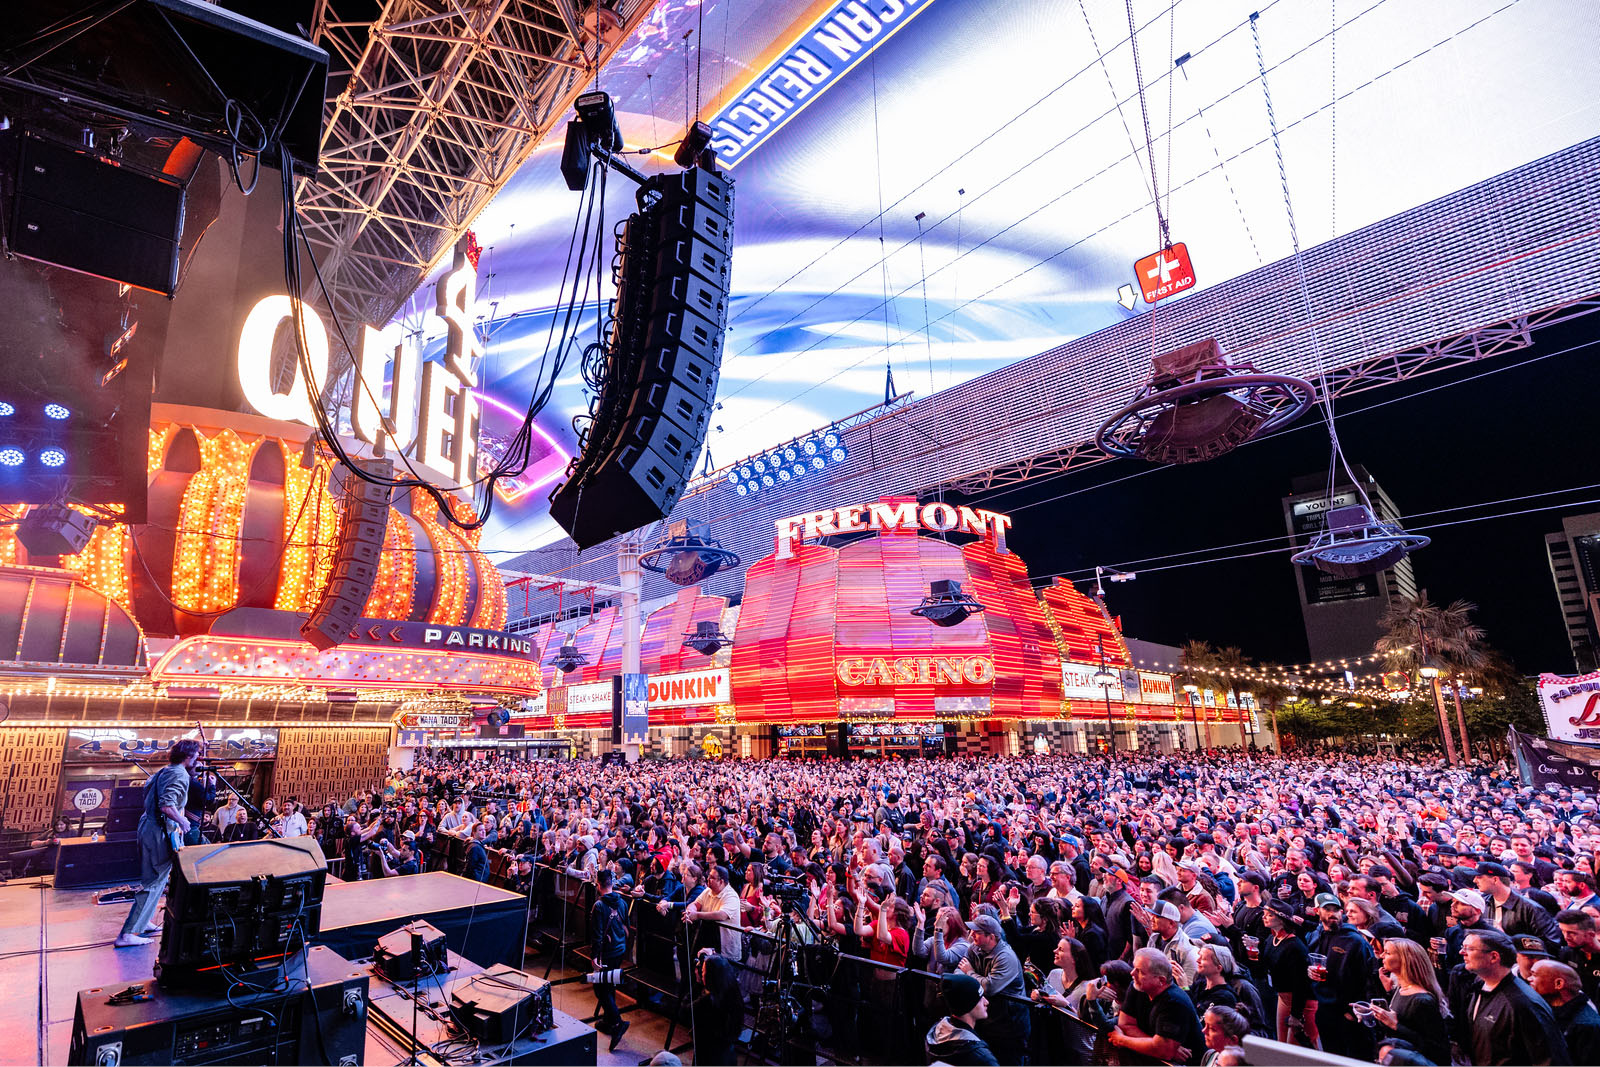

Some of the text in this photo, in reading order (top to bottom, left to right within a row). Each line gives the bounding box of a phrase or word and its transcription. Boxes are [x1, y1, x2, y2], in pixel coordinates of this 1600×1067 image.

[706, 47, 832, 157] REJECTS
[1146, 276, 1192, 300] FIRST AID
[1305, 502, 1326, 511] YOU
[774, 501, 1012, 561] FREMONT
[424, 628, 531, 654] PARKING
[837, 655, 995, 686] CASINO
[1064, 671, 1091, 688] STEAK
[569, 694, 588, 704] STEAK
[591, 691, 612, 702] SHAKE
[647, 674, 722, 703] DUNKIN'
[440, 715, 458, 725] TACO
[78, 739, 268, 751] 4 QUENS
[79, 798, 97, 806] TACO
